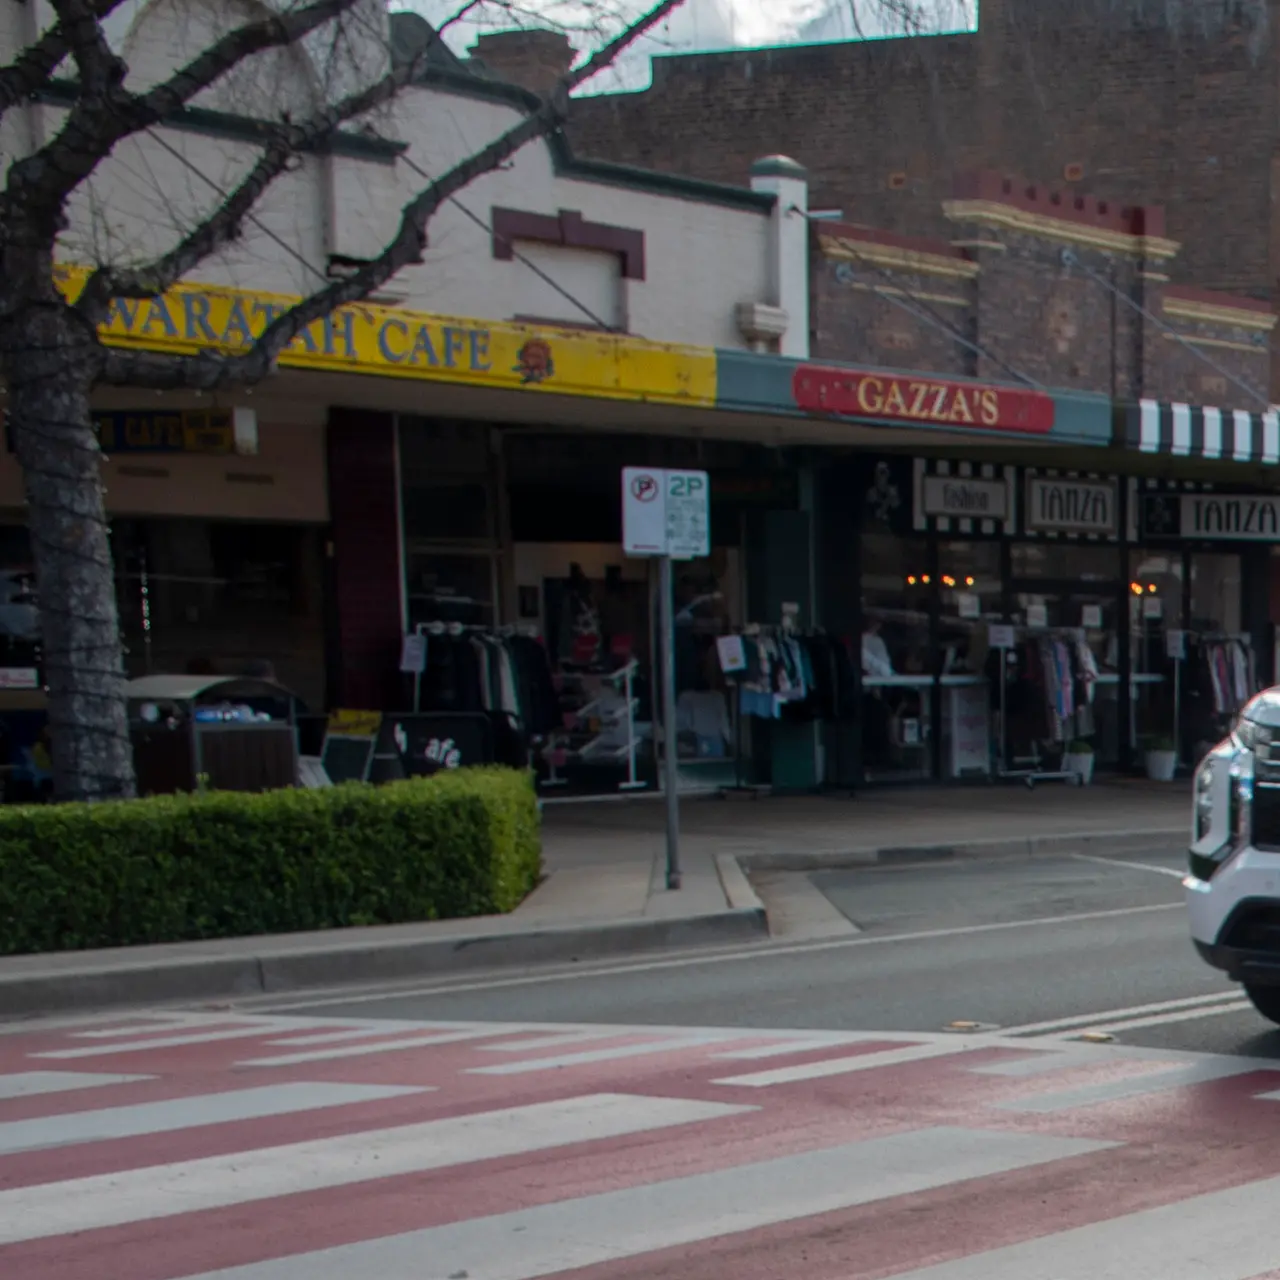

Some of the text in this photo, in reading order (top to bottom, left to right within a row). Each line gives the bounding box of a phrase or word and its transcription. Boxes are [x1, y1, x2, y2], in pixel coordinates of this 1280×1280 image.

[378, 317, 494, 372] CAFE
[857, 376, 999, 426] GAZZA'S
[669, 475, 704, 497] 2P
[1038, 486, 1109, 524] TANZA
[1194, 500, 1278, 534] TANZA
